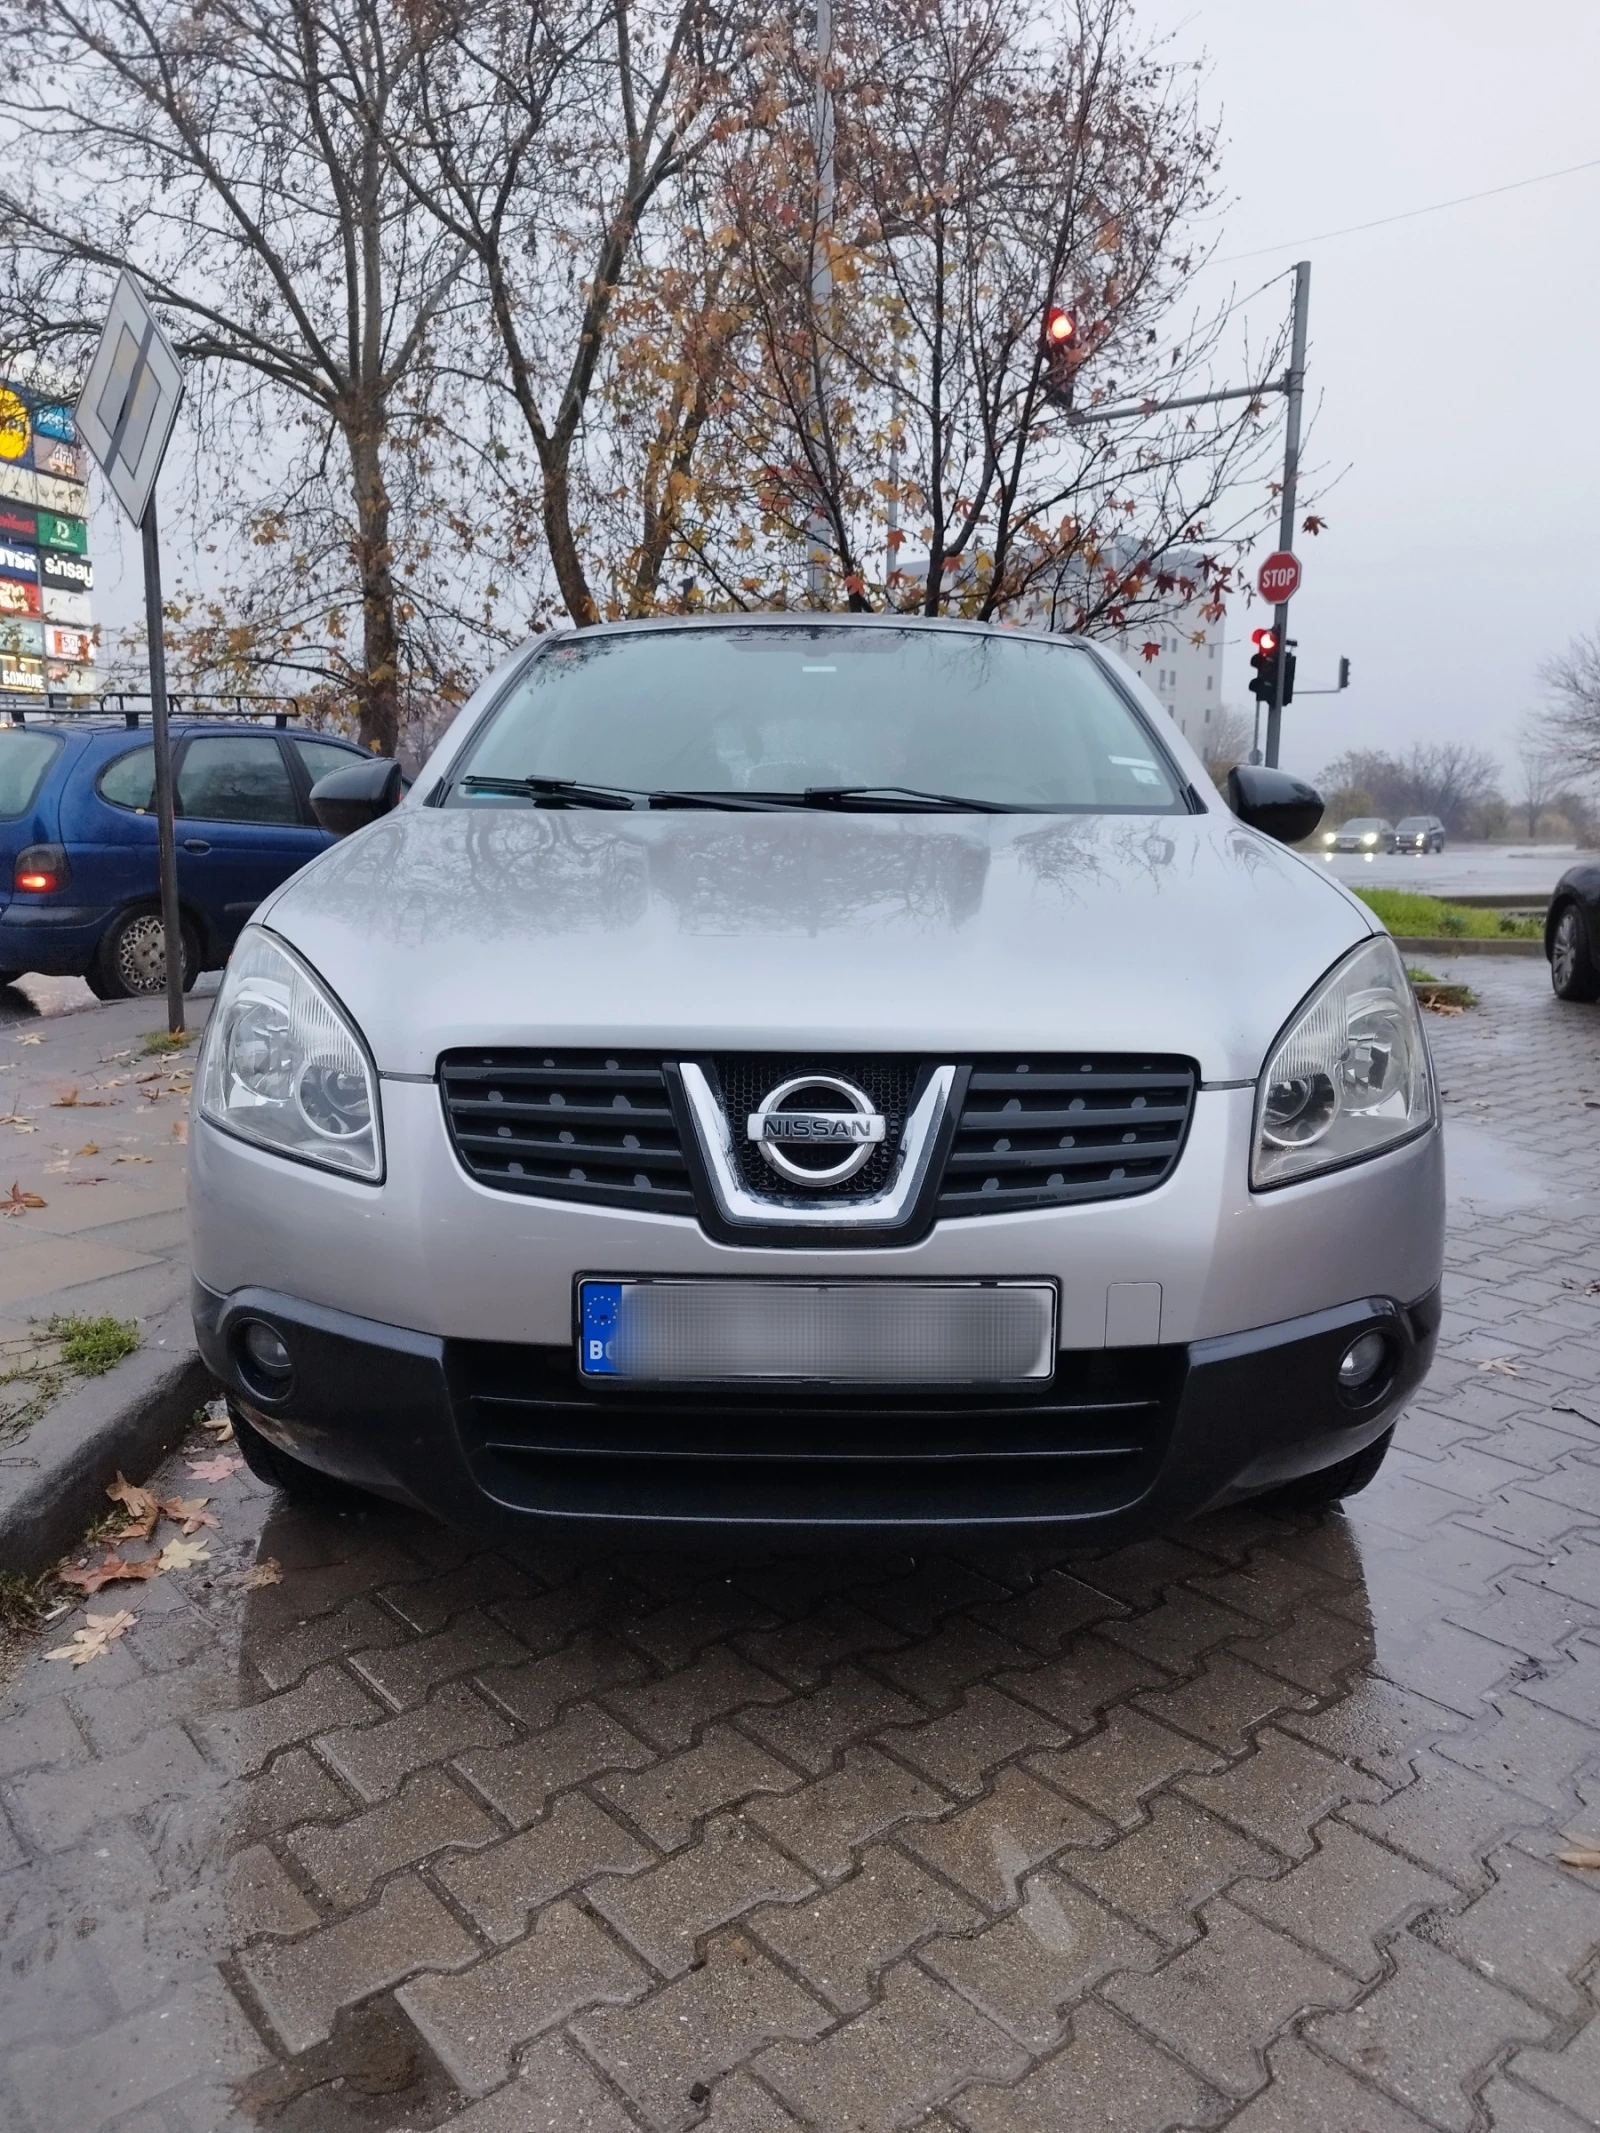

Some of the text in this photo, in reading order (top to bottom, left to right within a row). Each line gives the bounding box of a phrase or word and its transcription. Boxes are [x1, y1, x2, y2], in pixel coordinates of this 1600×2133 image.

[45, 553, 93, 588] sinsay
[1262, 567, 1296, 588] STOP
[763, 1119, 871, 1138] NISSAN
